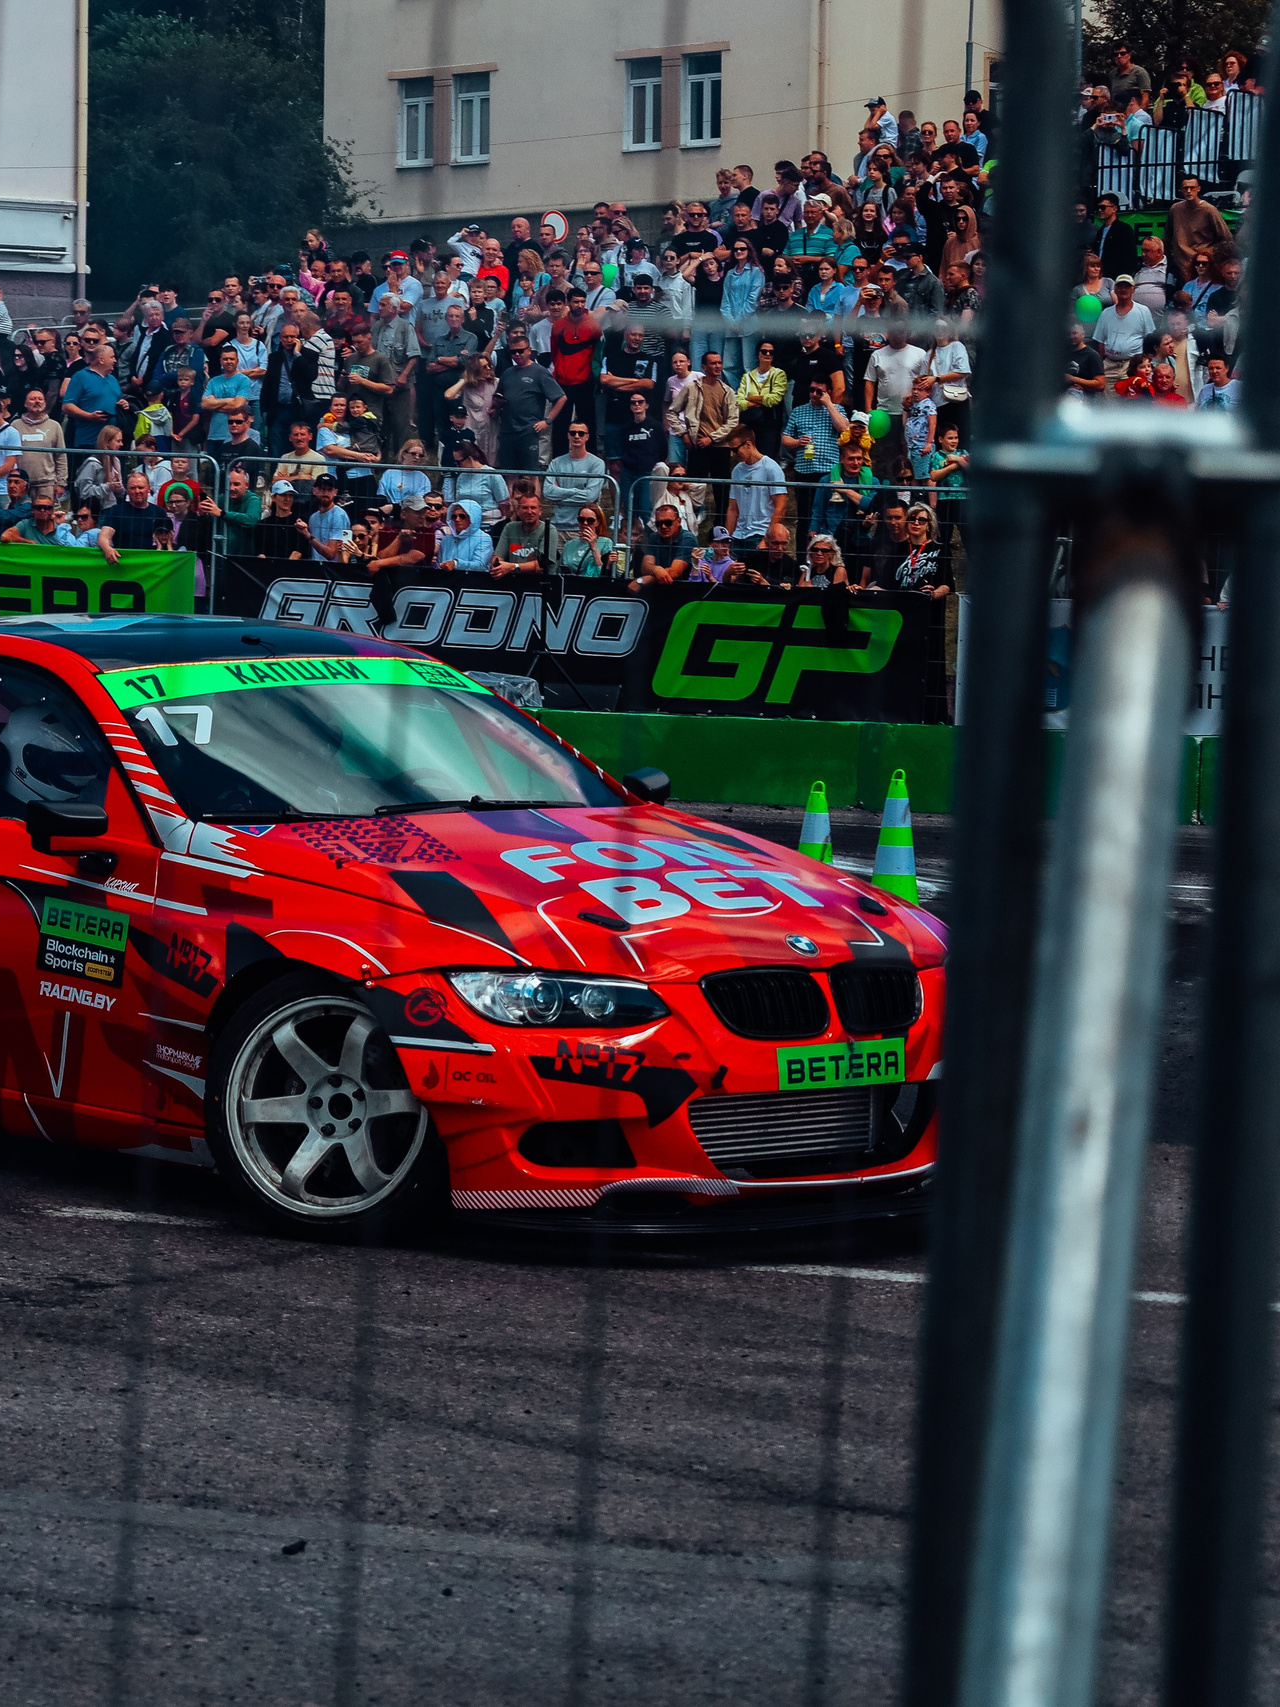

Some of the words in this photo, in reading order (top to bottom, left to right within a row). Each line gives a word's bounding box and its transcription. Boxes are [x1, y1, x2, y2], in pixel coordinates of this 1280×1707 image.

[259, 577, 650, 658] GRODNO
[651, 600, 904, 704] GP
[124, 673, 166, 699] 17
[224, 659, 370, 685] КАПШАЙ
[134, 705, 214, 747] 17
[500, 840, 755, 883] FON
[578, 869, 824, 926] BET
[45, 952, 84, 972] Sports
[46, 938, 108, 963] Blockchain
[40, 980, 116, 1011] RACING.BY
